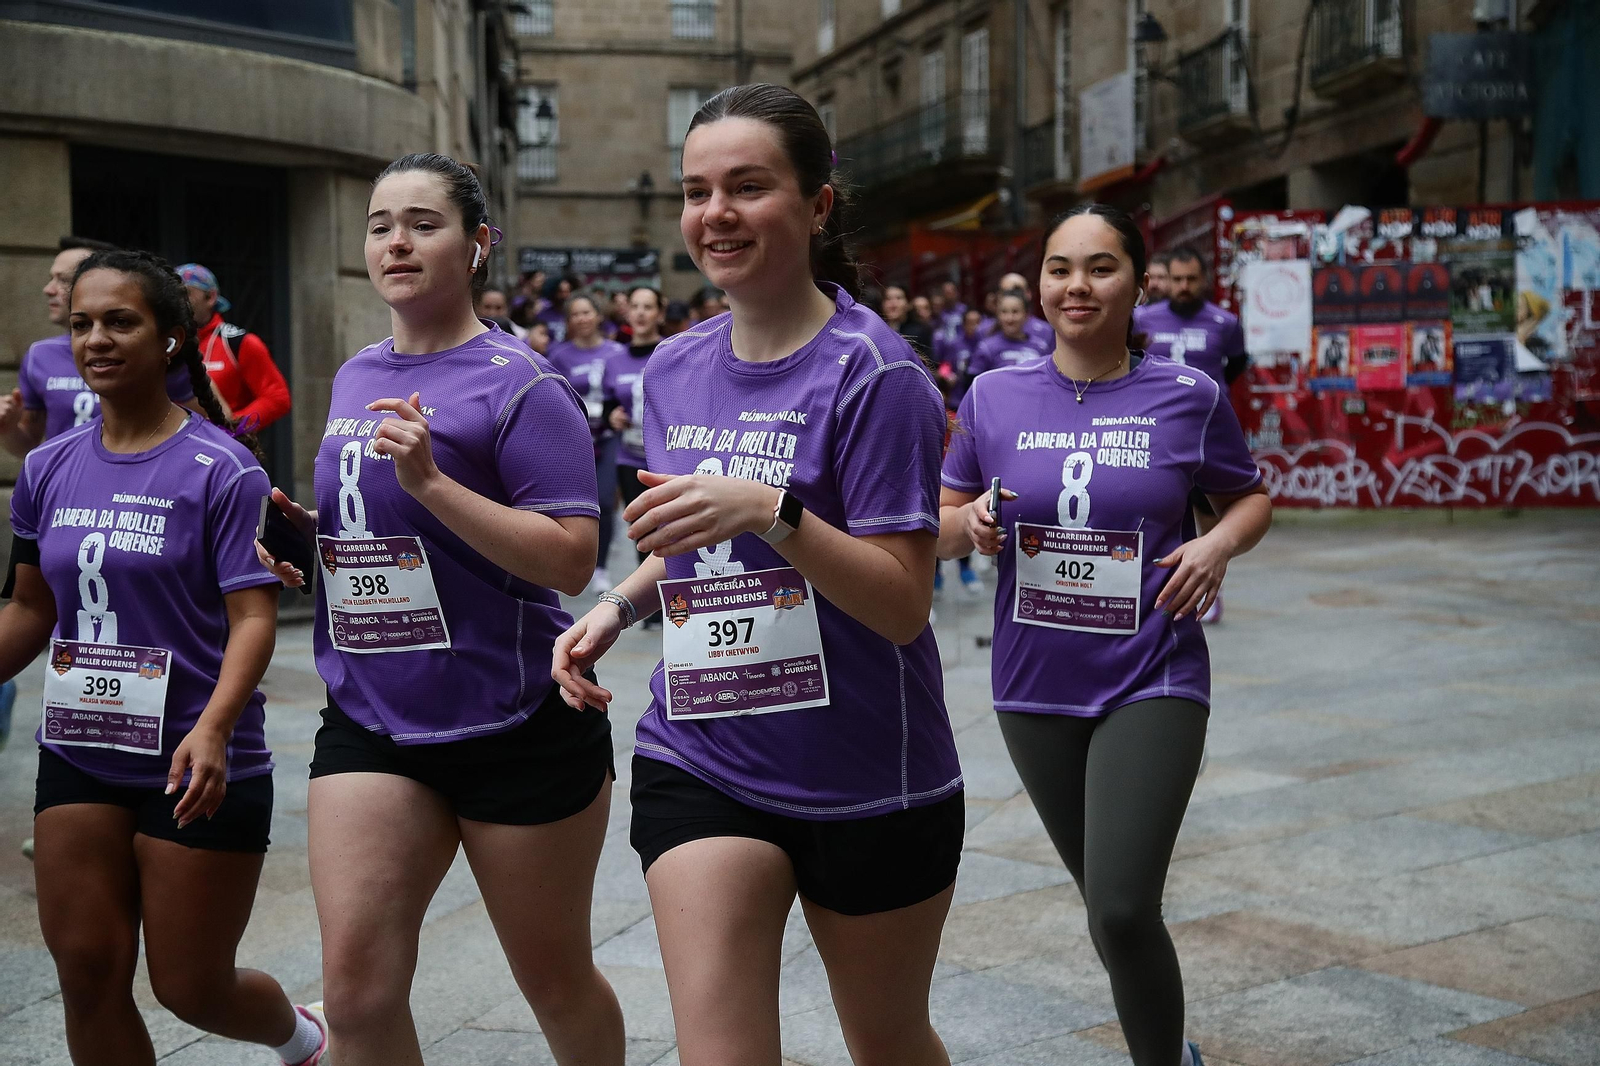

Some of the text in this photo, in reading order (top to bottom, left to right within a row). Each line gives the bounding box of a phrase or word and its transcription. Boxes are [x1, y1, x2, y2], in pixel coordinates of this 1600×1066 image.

[357, 420, 378, 436] DA
[666, 425, 797, 459] CARREIRA DA MULLER
[1017, 431, 1150, 450] CARREIRA DA MULLER
[1097, 448, 1150, 469] OURENSE
[727, 455, 794, 487] OURENSE
[52, 508, 166, 534] CARREIRA DA MULLER
[1056, 532, 1093, 541] CARREIRA
[109, 531, 165, 556] OURENSE
[342, 544, 375, 552] CARREIRA
[376, 543, 388, 551] DA
[1043, 541, 1108, 552] MULLER OURENSE
[360, 554, 393, 563] OURENSE
[1055, 560, 1095, 580] 402
[349, 575, 389, 596] 398
[691, 578, 762, 594] VII CARREIRA DA
[1056, 580, 1079, 588] CHRISTINA
[353, 598, 378, 606] ELIZABETH
[378, 596, 410, 605] MULHOLLAND
[692, 591, 768, 608] MULLER OURENSE
[1044, 593, 1076, 604] ABANCA
[350, 616, 379, 624] ABANCA
[708, 617, 755, 647] 397
[78, 646, 136, 658] VII CARREIRA DA
[708, 646, 760, 658] LIBBY CHETWYND
[75, 657, 137, 669] MULLER OURENSE
[785, 664, 818, 674] OURENSE
[700, 671, 739, 682] ABANCA
[82, 676, 121, 697] 399
[718, 692, 737, 700] ABRIL
[71, 712, 103, 722] ABANCA
[134, 721, 157, 729] OURENSE
